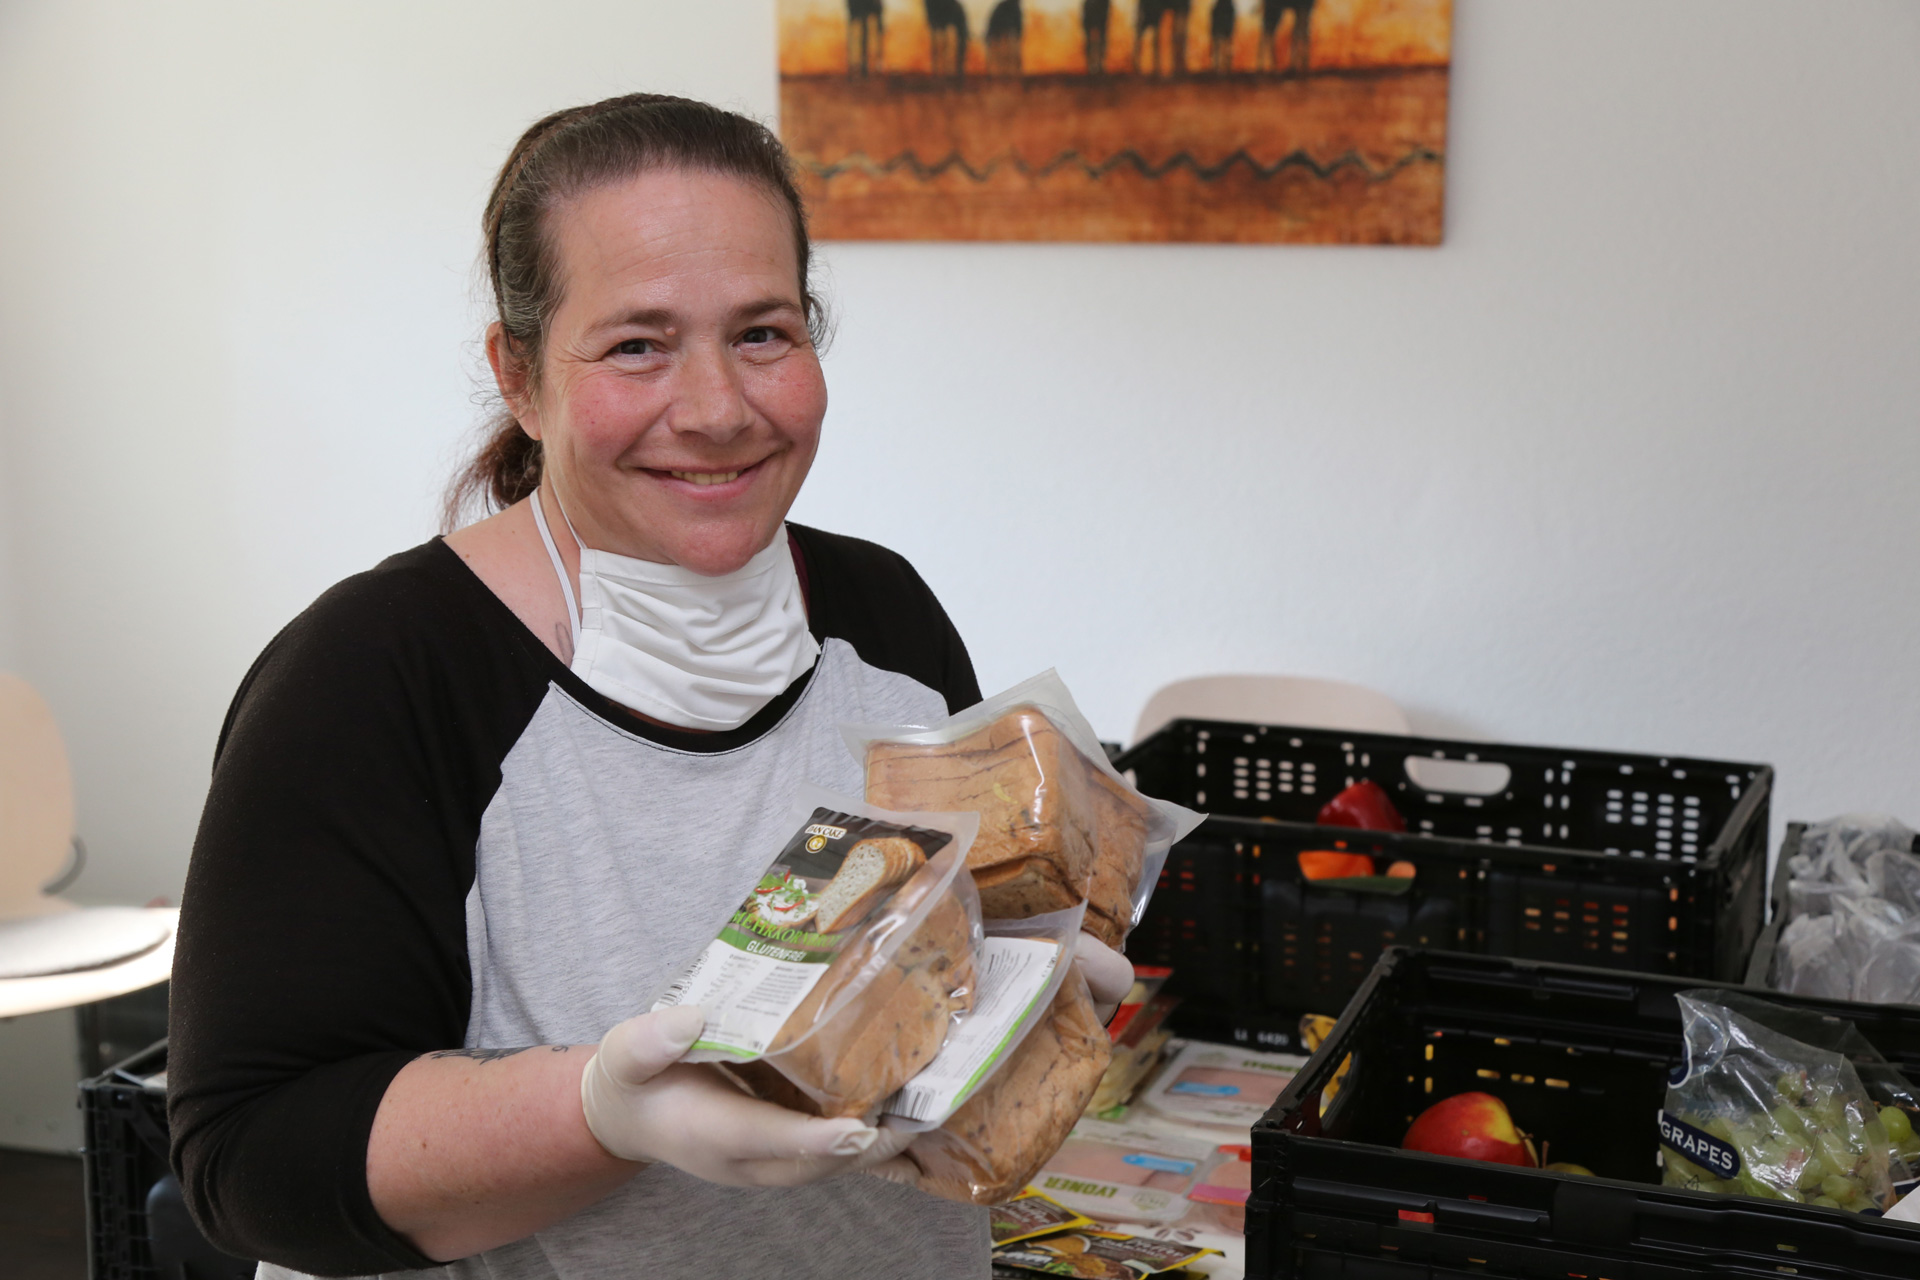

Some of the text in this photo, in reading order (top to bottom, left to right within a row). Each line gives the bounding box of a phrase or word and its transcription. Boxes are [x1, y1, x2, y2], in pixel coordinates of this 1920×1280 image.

[808, 825, 844, 838] DAN CAKE
[732, 910, 844, 947] MEHRKORNBROT
[746, 940, 807, 961] GLUTENFREI
[1660, 1121, 1733, 1170] GRAPES
[1043, 1176, 1118, 1199] LYONER
